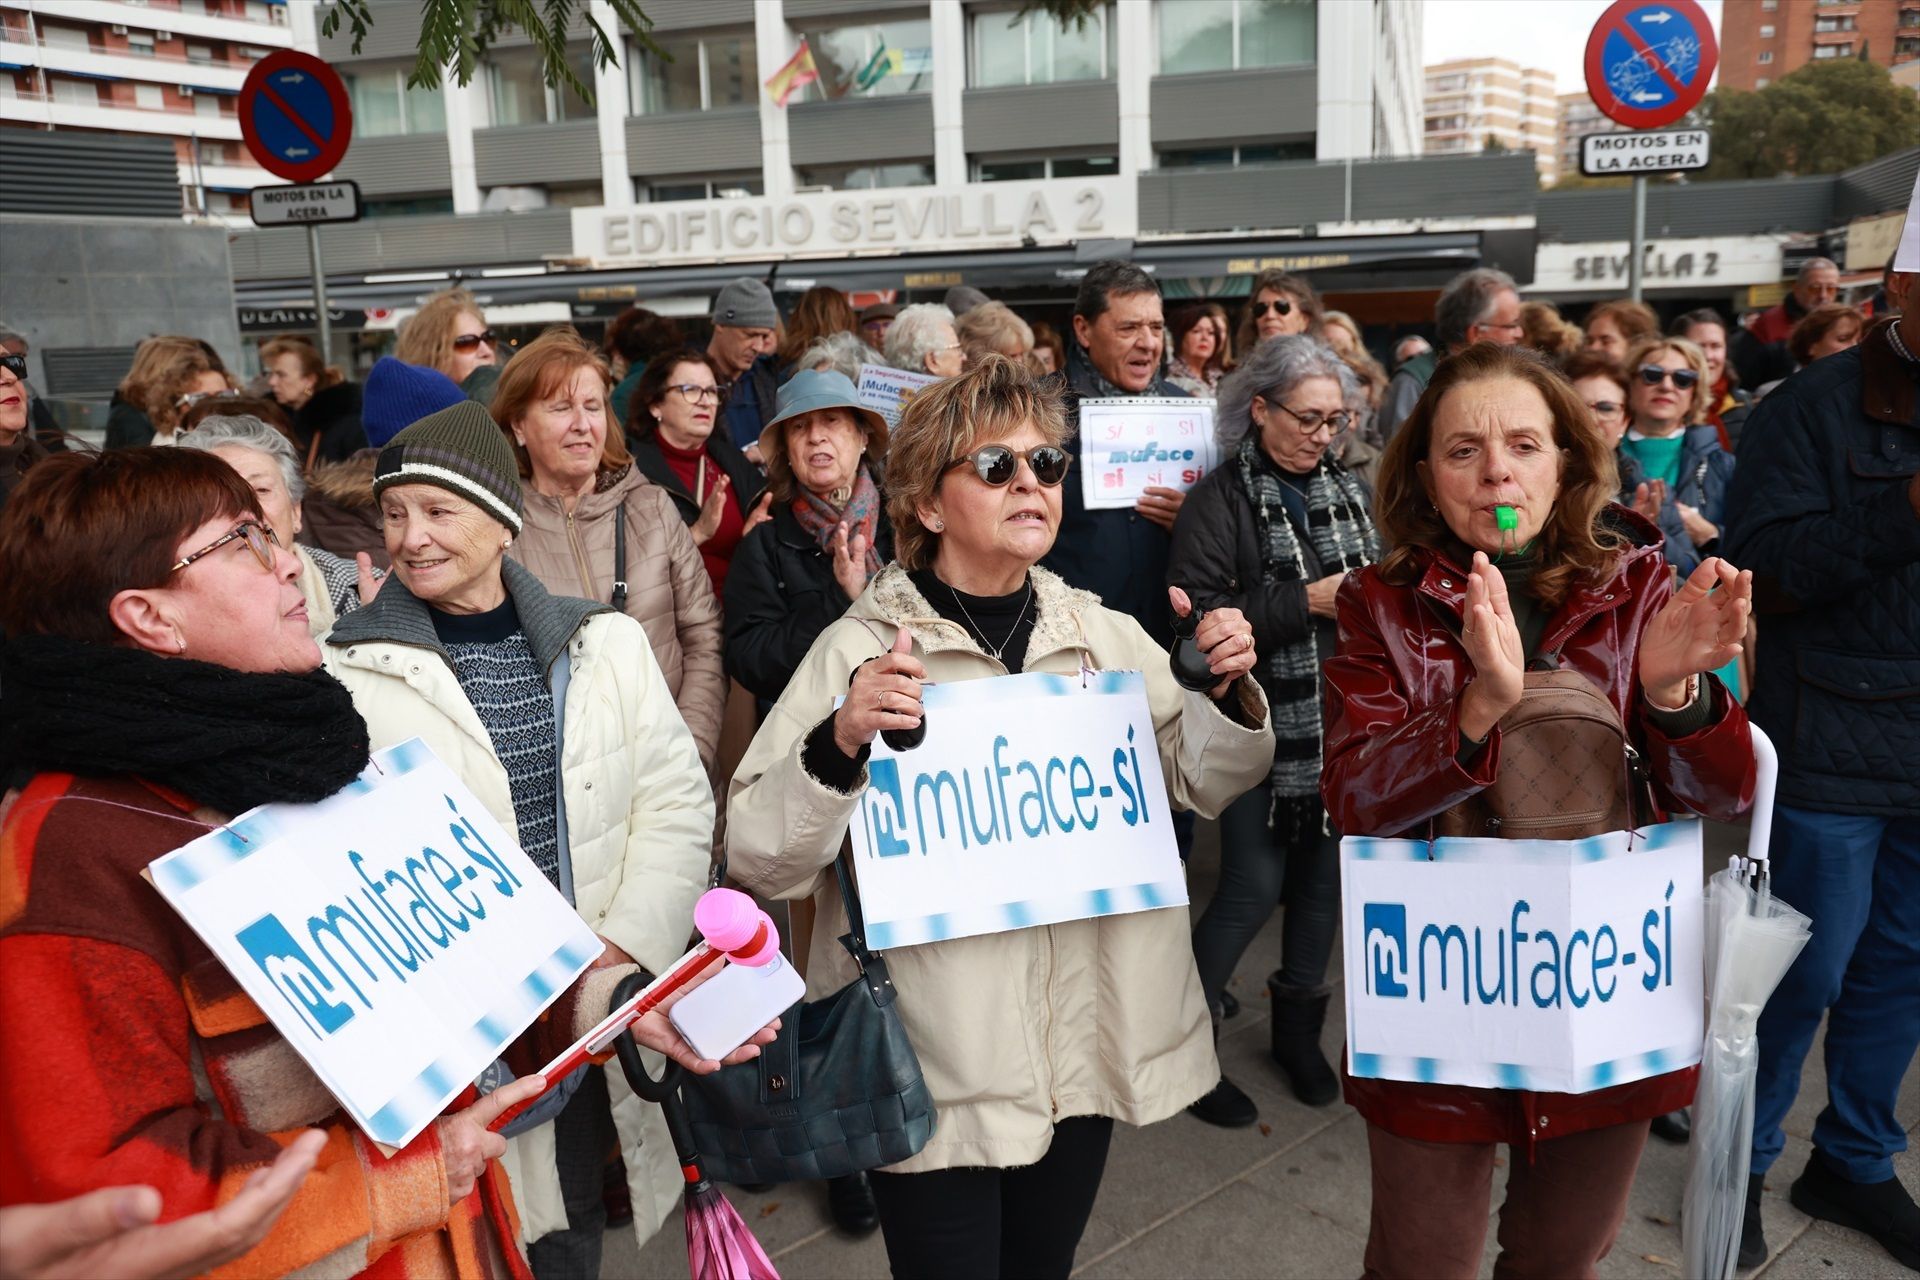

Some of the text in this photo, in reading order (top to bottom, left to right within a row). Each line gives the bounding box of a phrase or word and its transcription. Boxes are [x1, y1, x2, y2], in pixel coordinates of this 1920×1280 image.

[1594, 134, 1702, 150] MOTOS EN
[1597, 153, 1699, 170] LA ACERA
[263, 186, 345, 205] MOTOS EN LA
[286, 206, 329, 219] ACERA
[603, 187, 1104, 256] EDIFICIO SEVILLA 2
[1703, 252, 1719, 277] 2
[914, 723, 1150, 854] muface-sí
[306, 797, 522, 1010] muface-sí
[1418, 880, 1675, 1010] muface-sí
